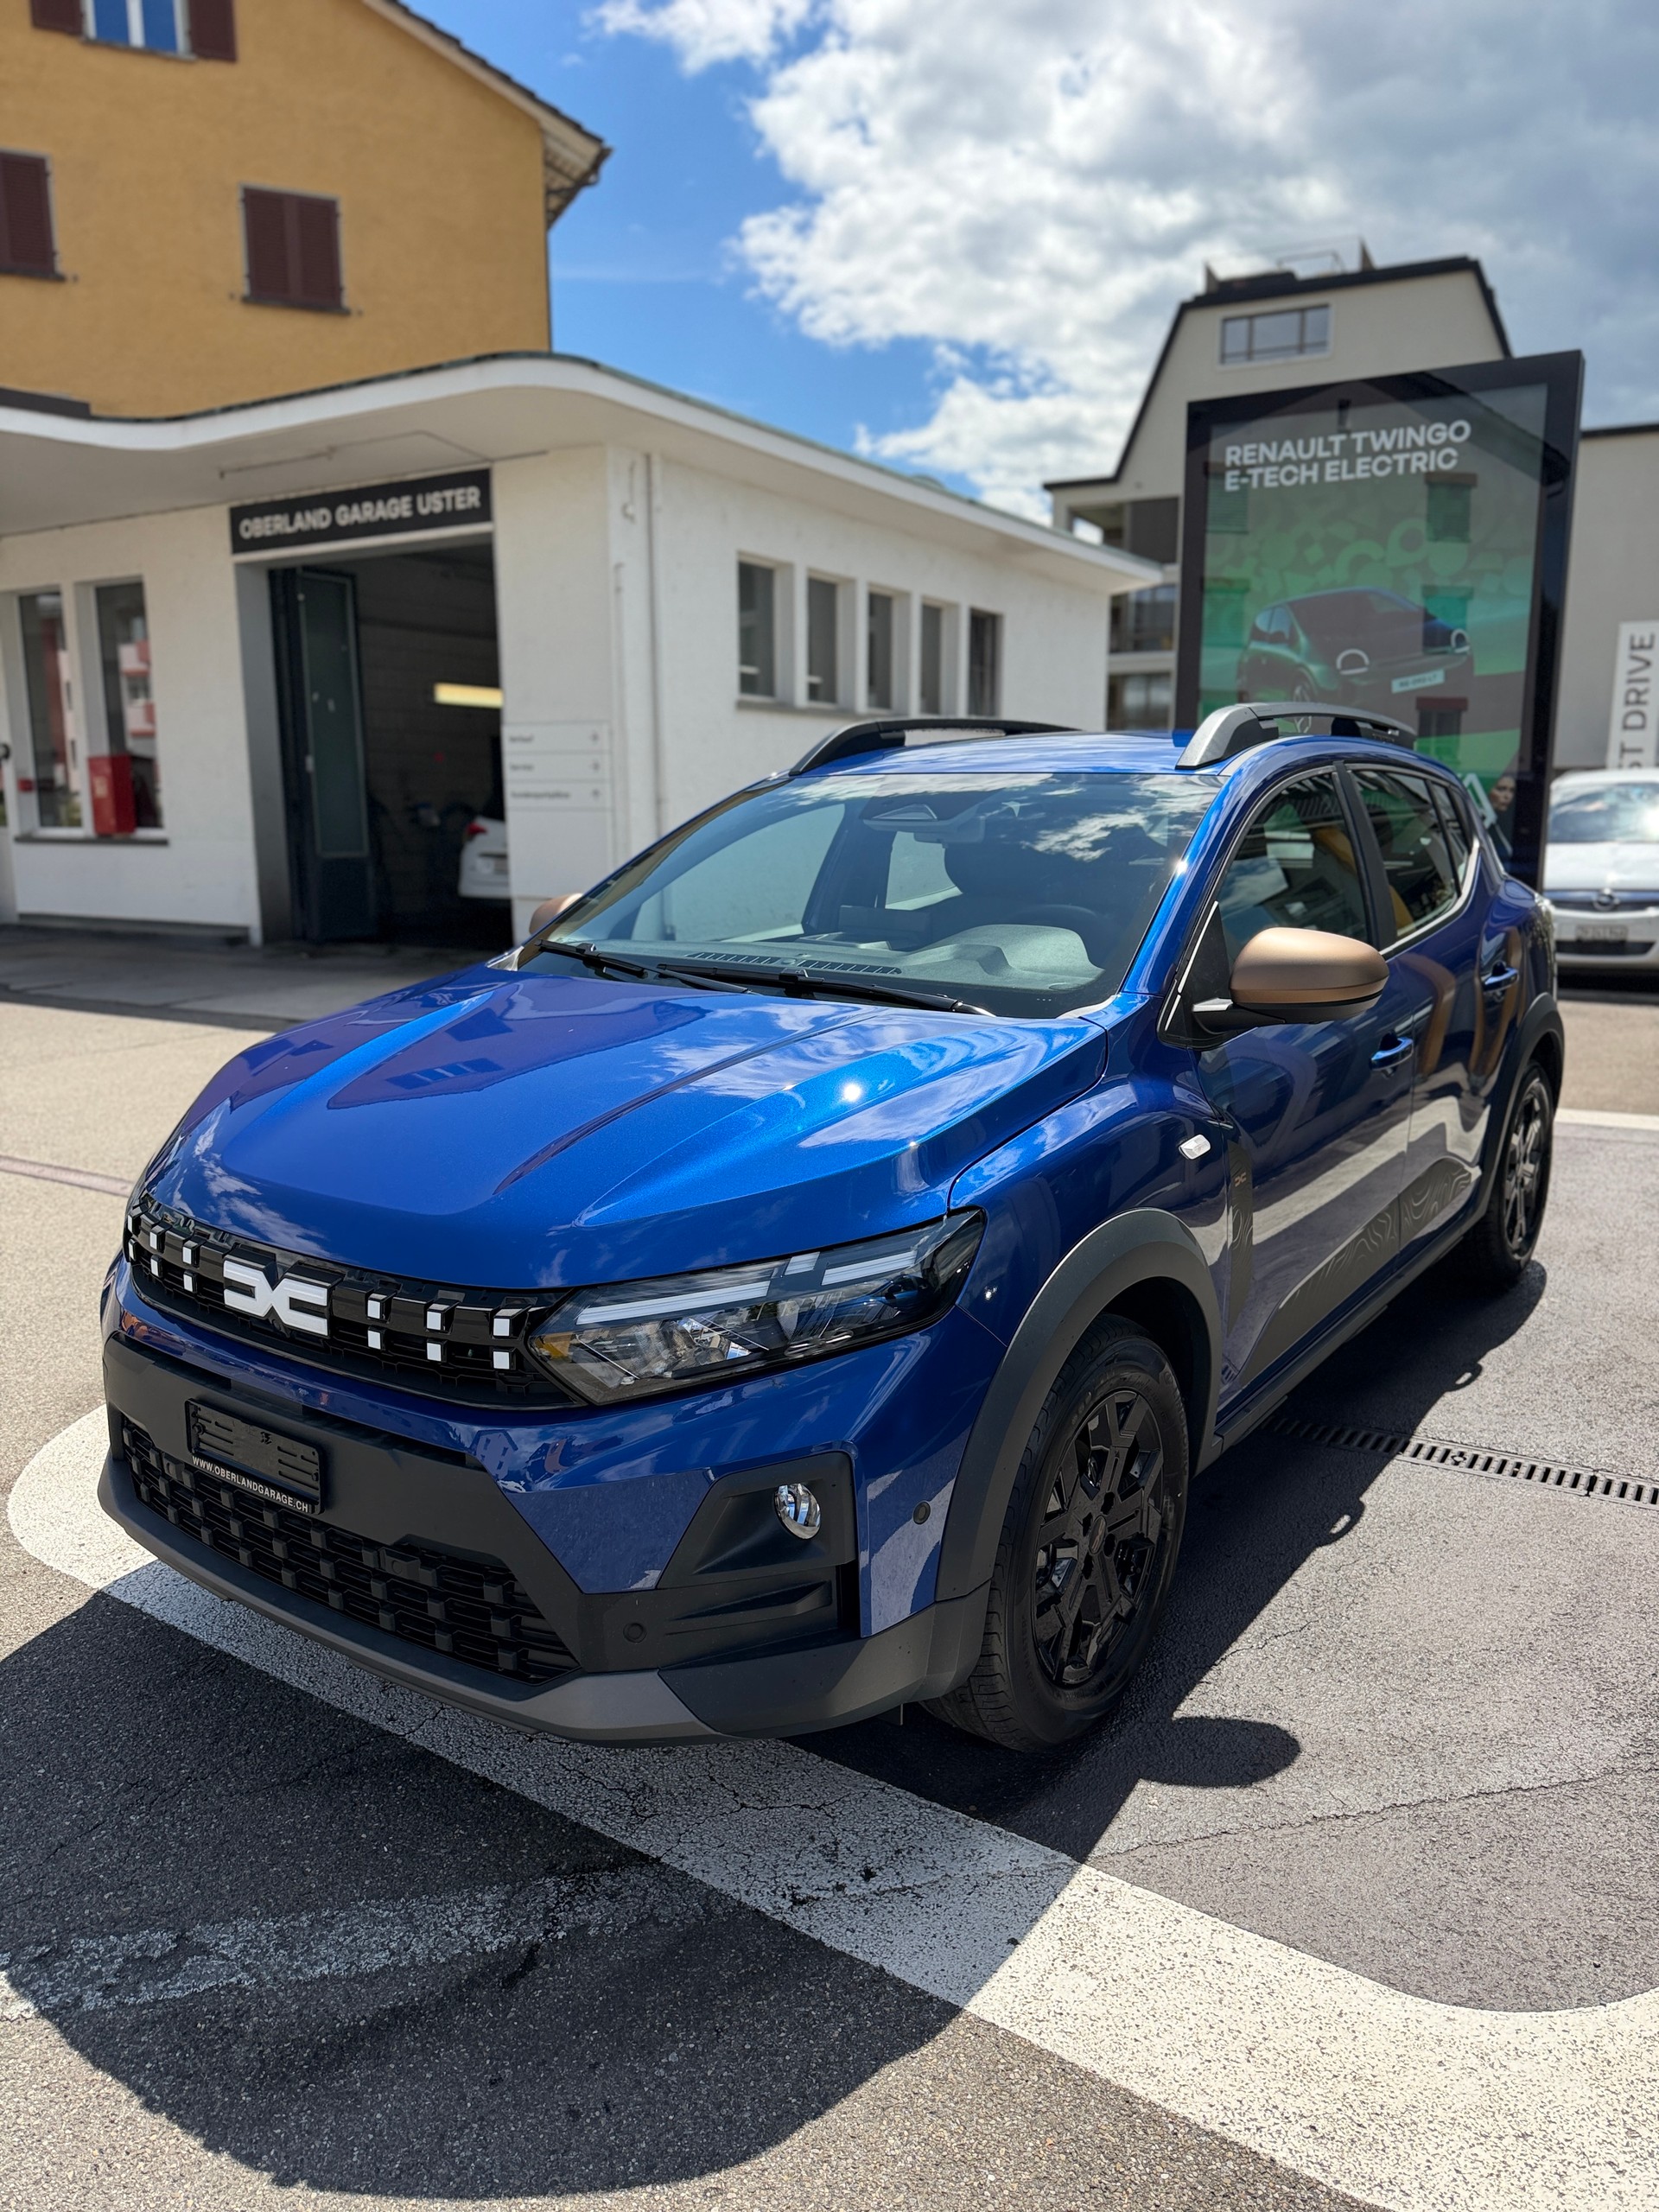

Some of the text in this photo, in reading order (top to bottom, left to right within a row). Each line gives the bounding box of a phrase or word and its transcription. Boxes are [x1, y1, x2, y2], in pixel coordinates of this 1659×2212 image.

[1224, 448, 1459, 492] E-TECH ELECTRIC
[1225, 420, 1471, 467] RENAULT TWINGO
[239, 486, 480, 540] OBERLAND GARAGE USTER
[1622, 632, 1656, 732] DRIVE
[192, 1456, 309, 1513] WWW.OBERLANDGARAGE.CH
